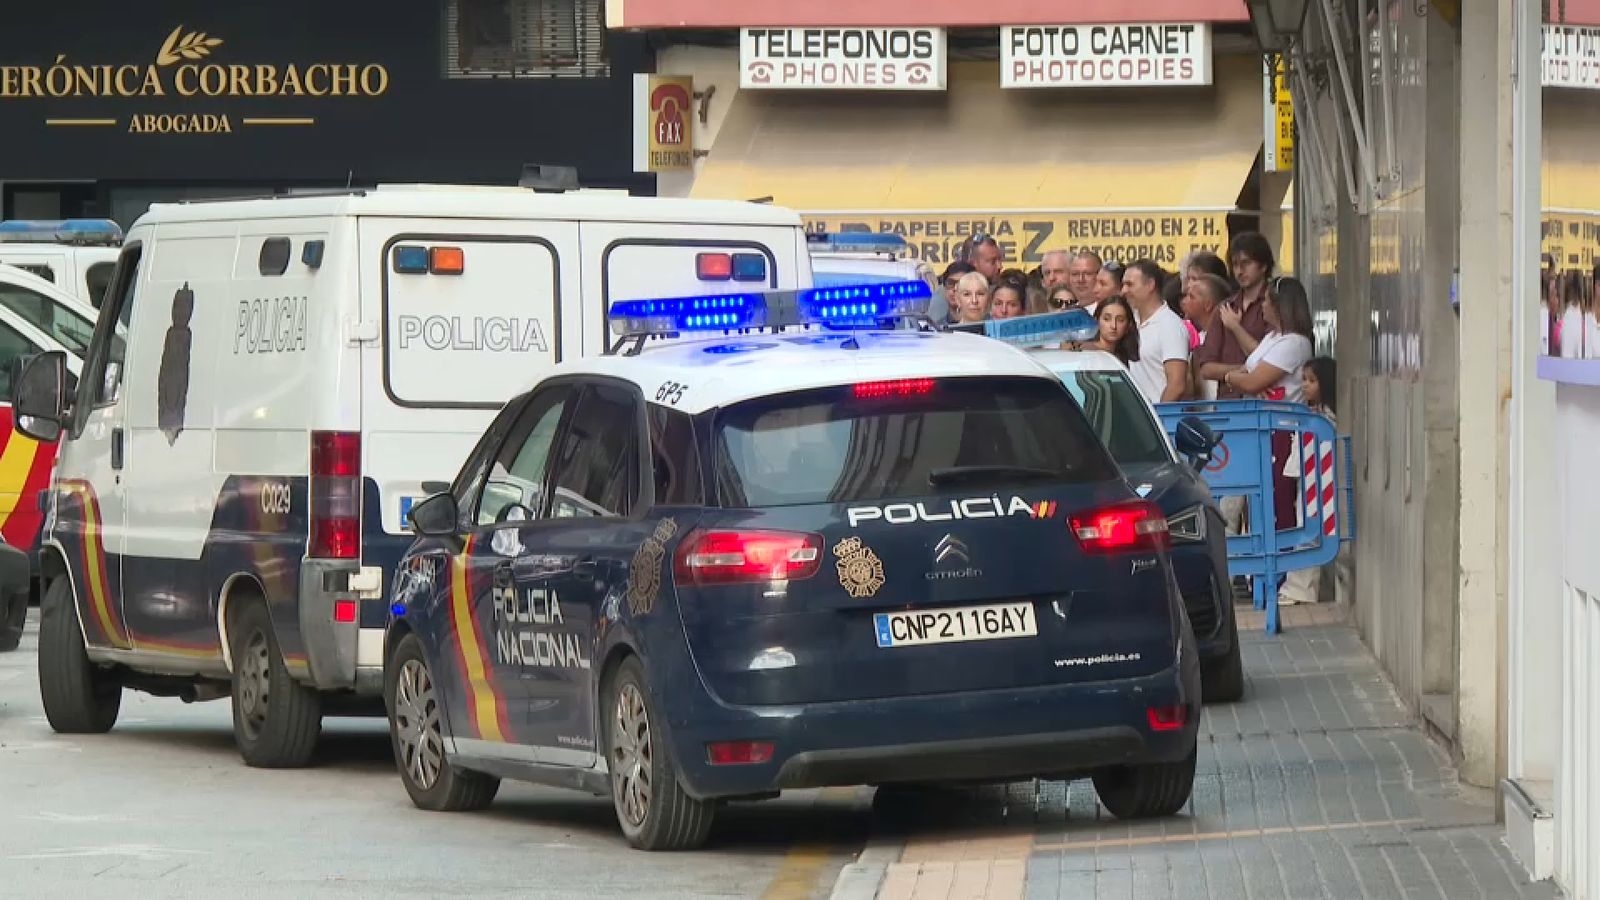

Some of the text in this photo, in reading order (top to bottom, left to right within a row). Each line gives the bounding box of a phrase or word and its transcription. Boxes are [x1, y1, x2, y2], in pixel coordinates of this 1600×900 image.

[748, 29, 932, 58] TELEFONOS
[1011, 25, 1194, 56] FOTO CARNET
[174, 63, 389, 97] CORBACHO
[783, 62, 896, 85] PHONES
[1013, 58, 1193, 81] PHOTOCOPIES
[128, 114, 231, 134] ABOGADA
[659, 122, 680, 143] FAX
[879, 216, 1014, 237] PAPELERÍA
[1068, 217, 1220, 238] REVELADO EN 2 H.
[234, 296, 307, 354] POLICIA
[399, 315, 549, 352] POLICIA
[656, 380, 688, 406] 6P5
[261, 483, 291, 514] C029
[848, 493, 1036, 527] POLICÍA
[493, 587, 564, 624] POLICIA
[890, 604, 1029, 641] CNP2116AY
[497, 629, 591, 669] NACIONAL
[1054, 652, 1141, 668] www.policia.es
